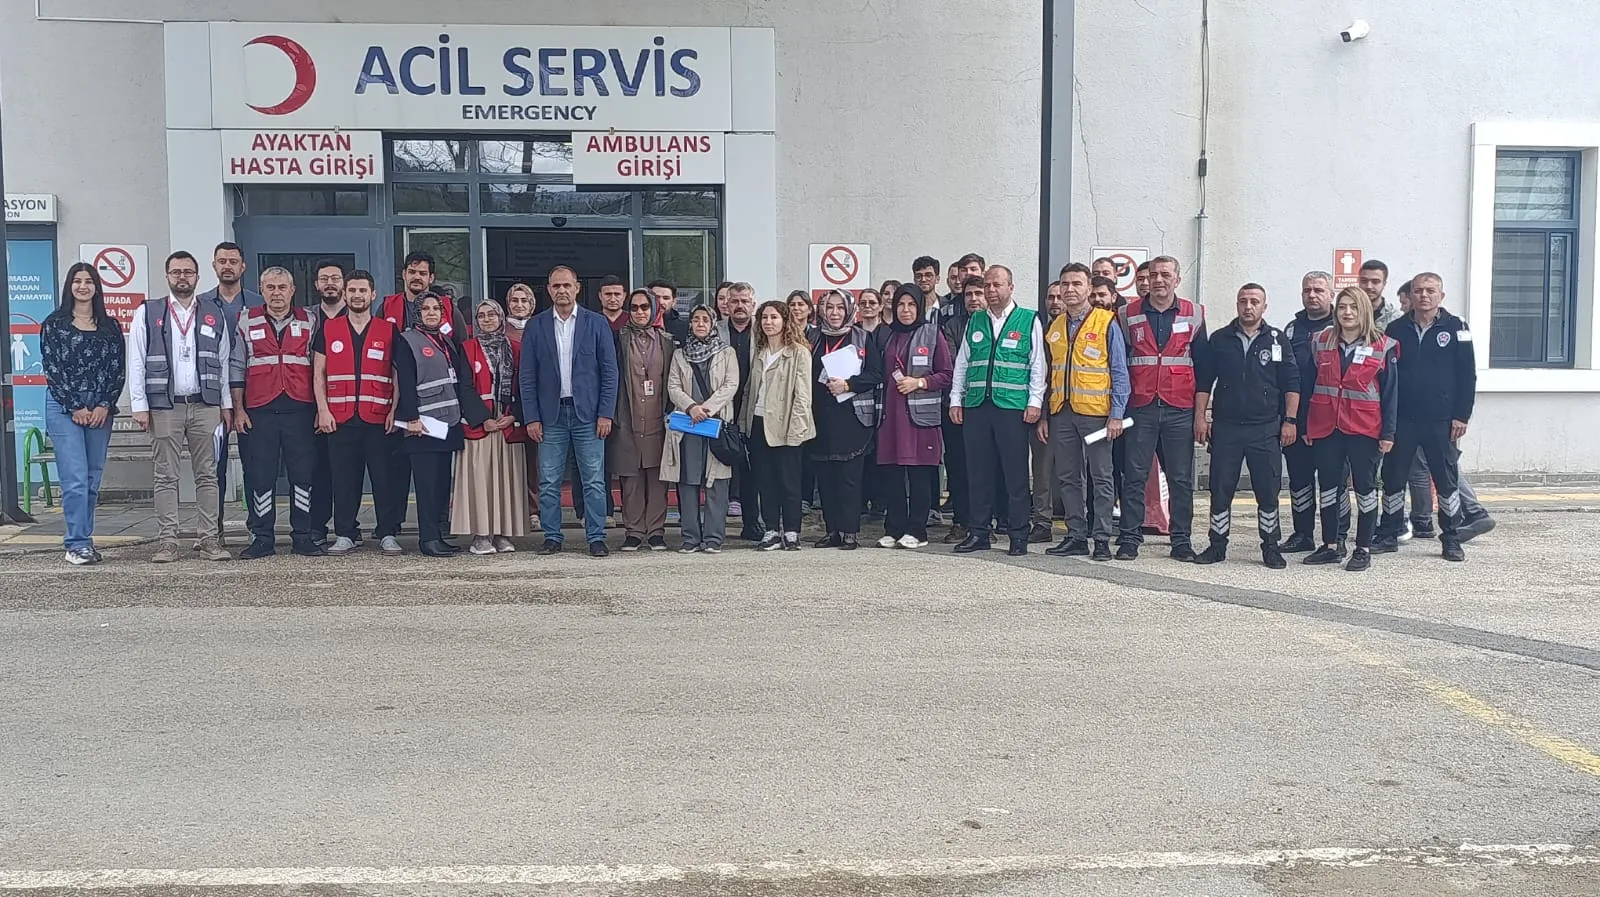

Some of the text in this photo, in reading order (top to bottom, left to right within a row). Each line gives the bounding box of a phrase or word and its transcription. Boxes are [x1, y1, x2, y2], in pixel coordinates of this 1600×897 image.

[354, 33, 701, 98] ACİL SERVİS
[462, 105, 597, 121] EMERGENCY
[252, 133, 351, 151] AYAKTAN
[586, 135, 711, 153] AMBULANS
[231, 153, 374, 179] HASTA GİRİŞİ
[617, 155, 681, 180] GİRİŞİ
[4, 199, 47, 210] ASYON
[9, 293, 52, 301] LANMAYIN
[104, 296, 132, 304] URADA
[118, 307, 134, 319] İÇM
